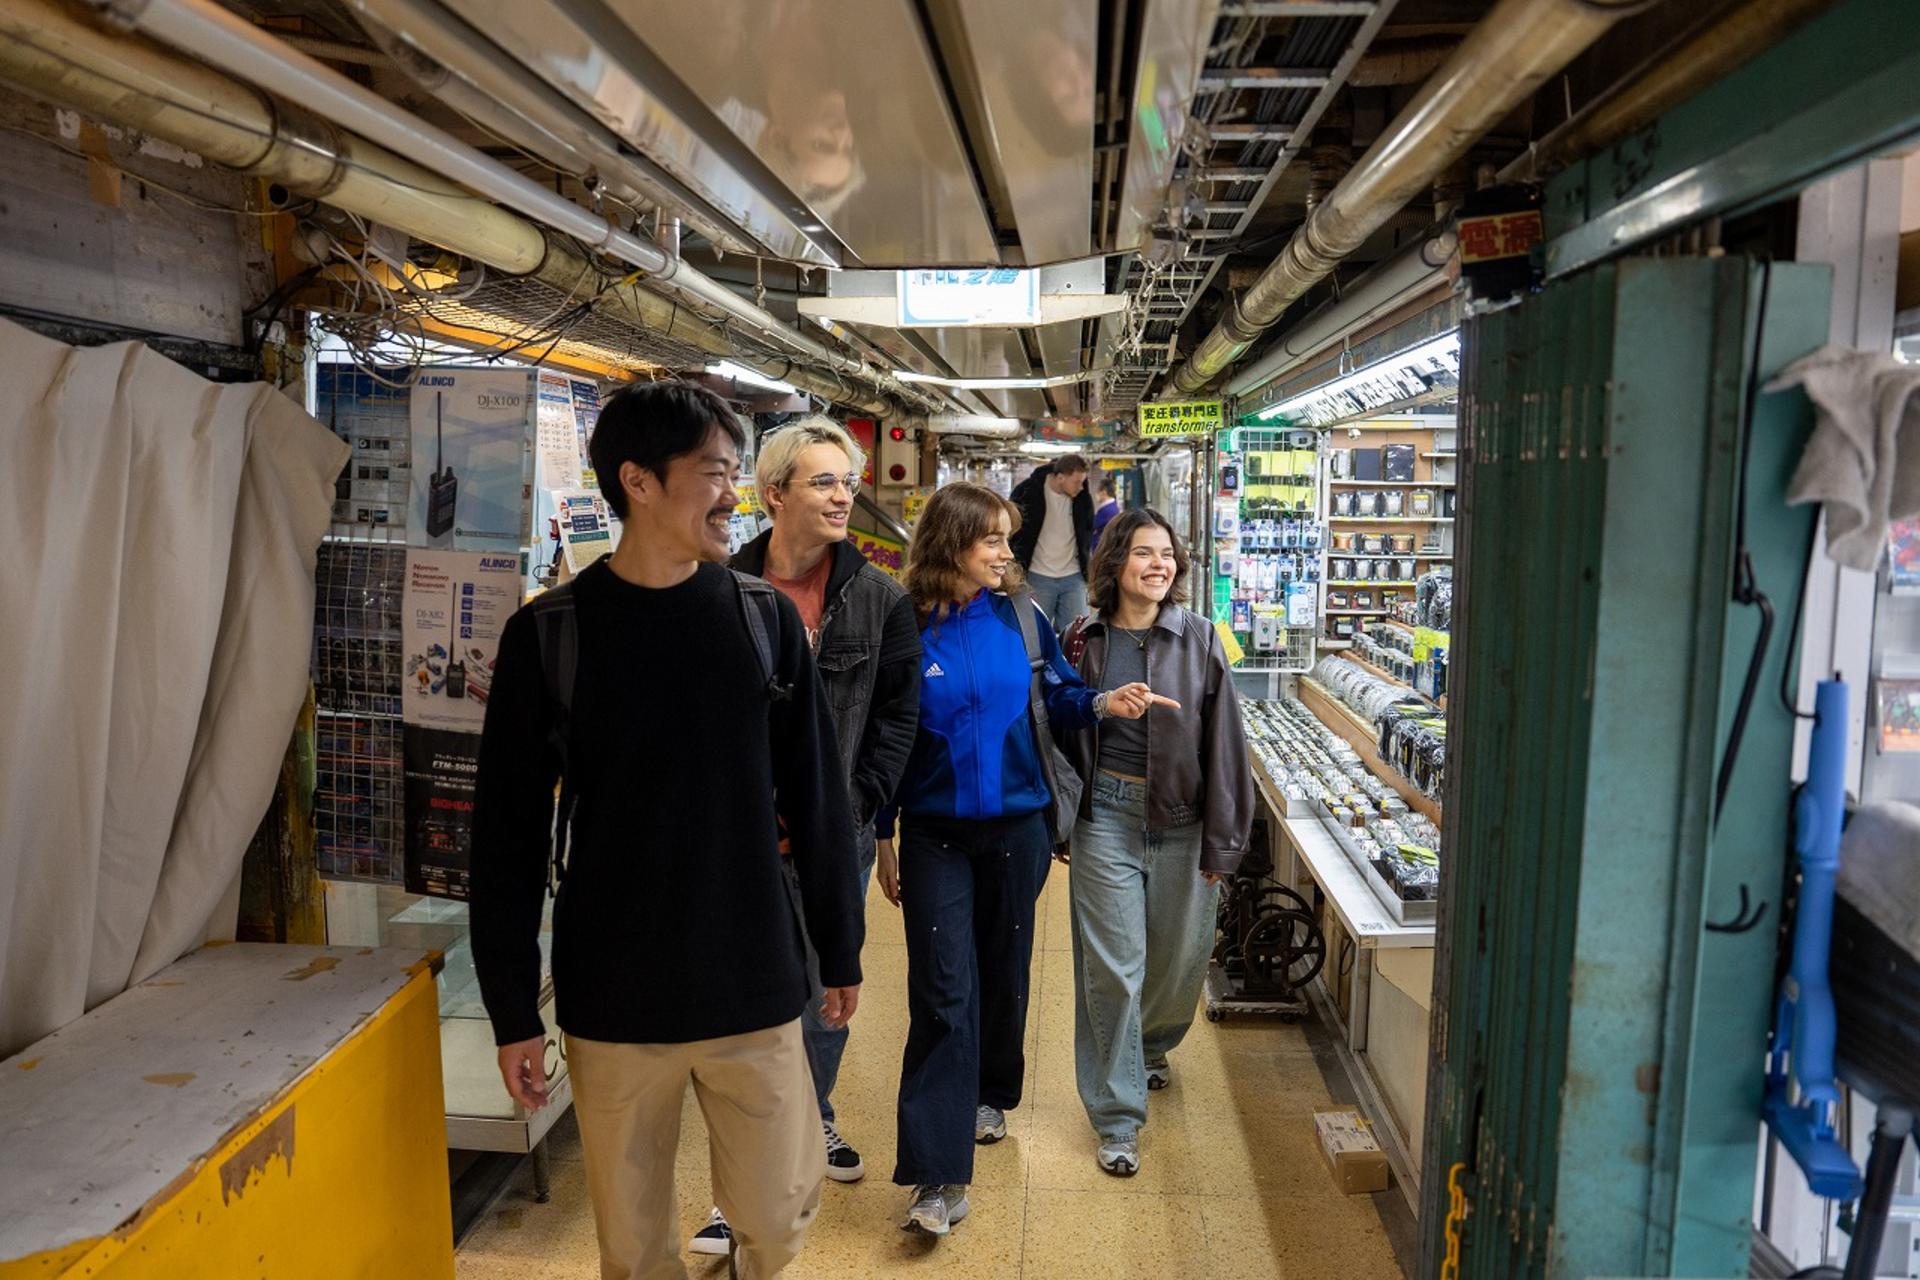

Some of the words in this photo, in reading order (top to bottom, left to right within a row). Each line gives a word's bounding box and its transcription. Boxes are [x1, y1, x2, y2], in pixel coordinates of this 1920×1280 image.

[419, 376, 455, 387] ALINCO
[477, 394, 520, 408] DJ-X100
[1145, 419, 1219, 434] transformer
[479, 558, 516, 569] ALINCO
[432, 760, 478, 773] FTM-500D
